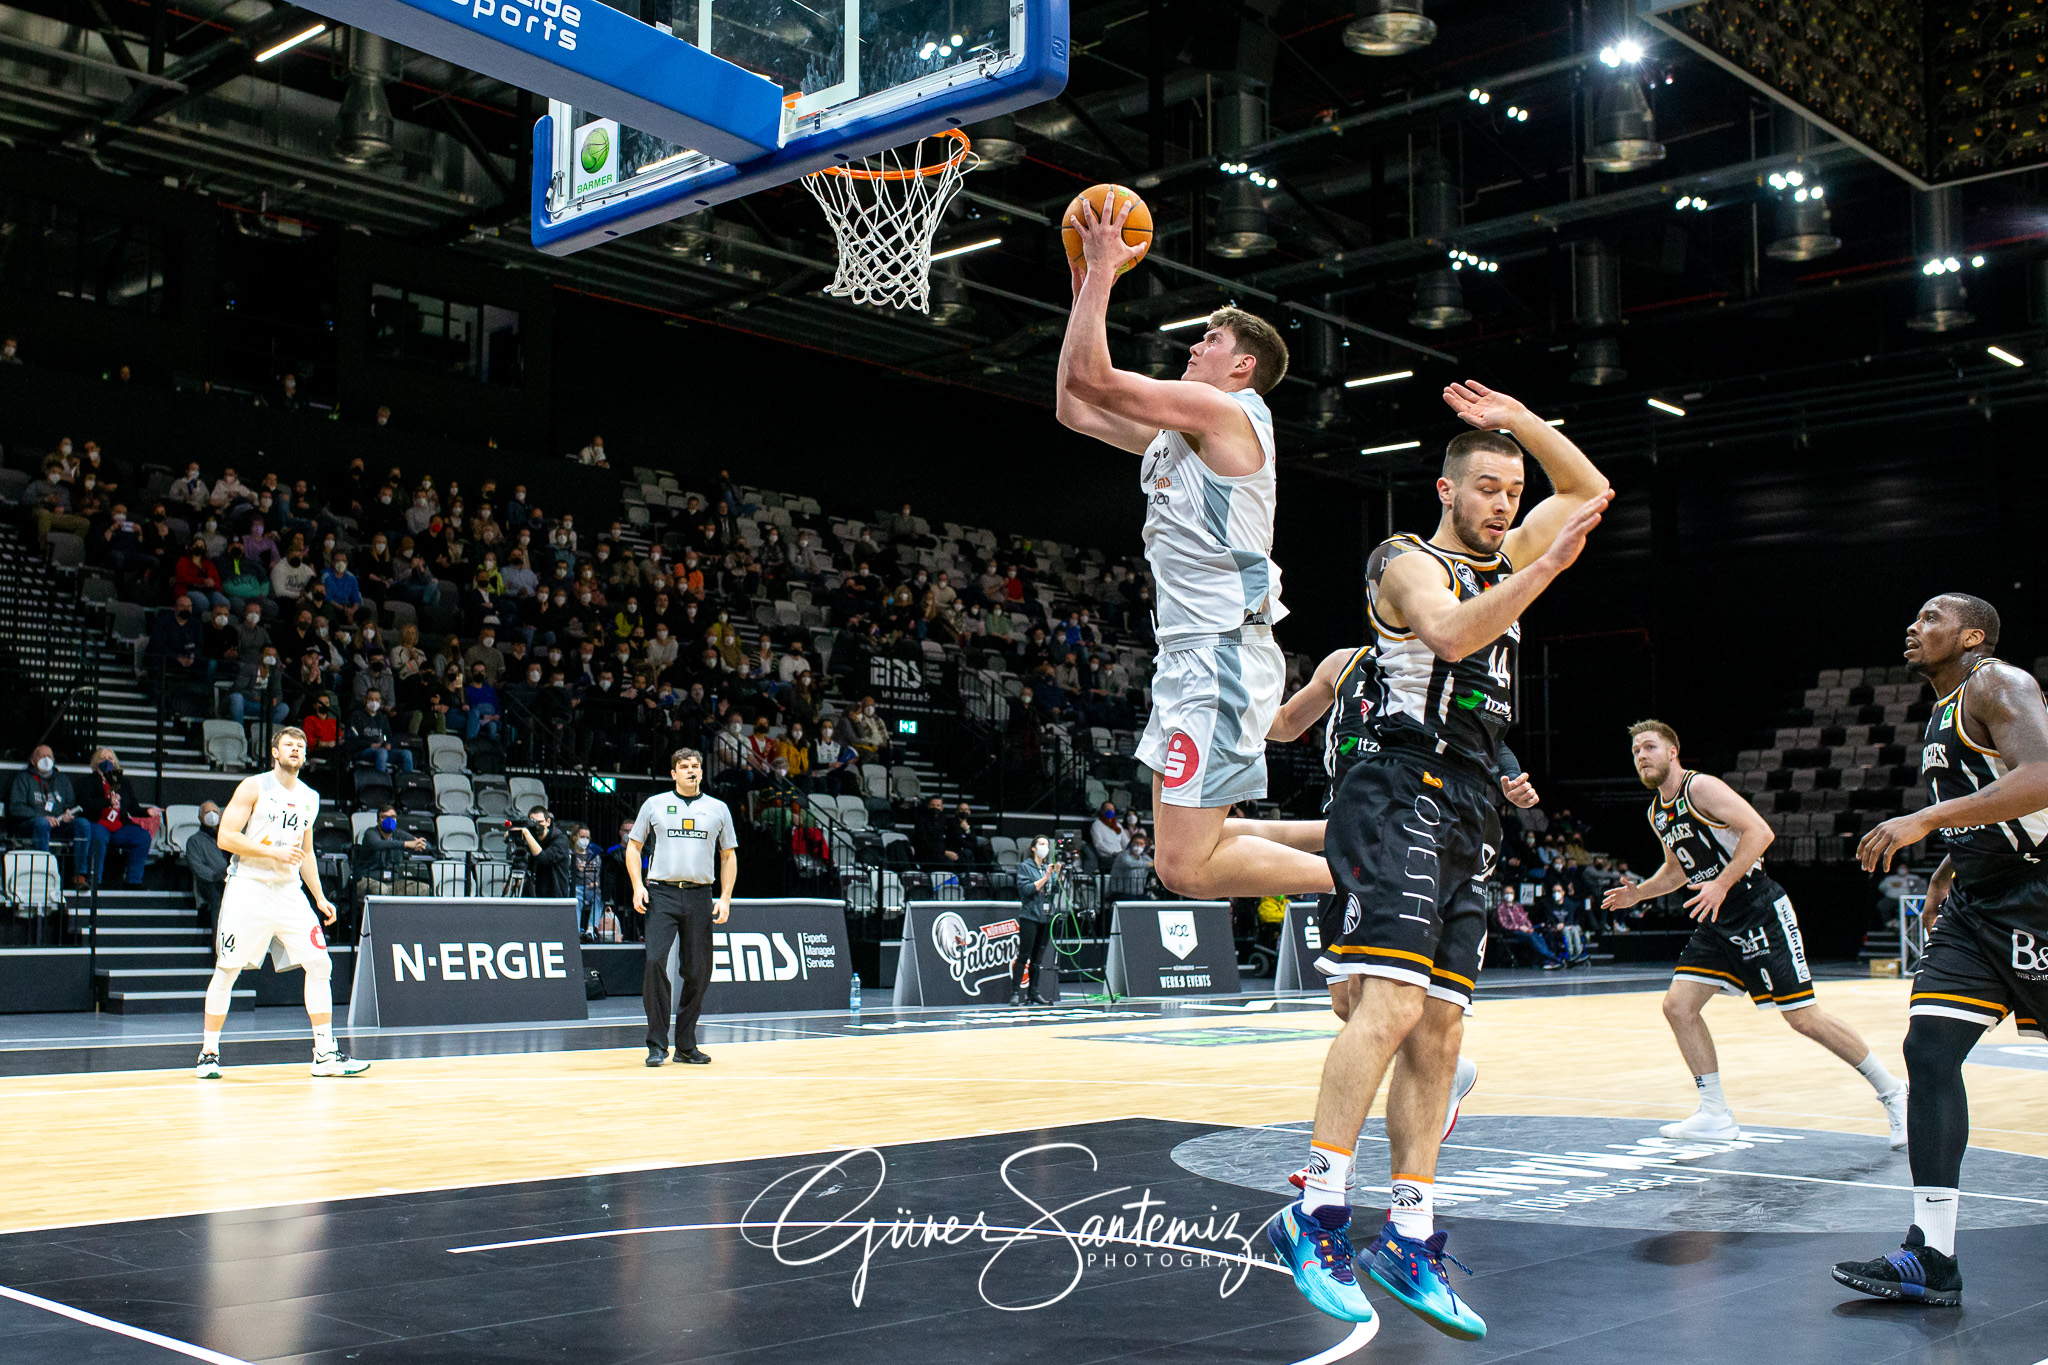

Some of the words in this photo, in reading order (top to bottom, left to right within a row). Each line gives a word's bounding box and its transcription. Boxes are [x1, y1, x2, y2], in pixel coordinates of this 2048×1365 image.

[577, 174, 613, 194] BARMER
[282, 810, 298, 831] 14
[668, 830, 708, 839] BALLSIDE
[1676, 847, 1696, 869] 9
[803, 932, 827, 944] Experts
[804, 945, 836, 957] Managed
[806, 957, 834, 968] Services
[1186, 974, 1211, 988] EVENTS
[1760, 967, 1774, 991] 9
